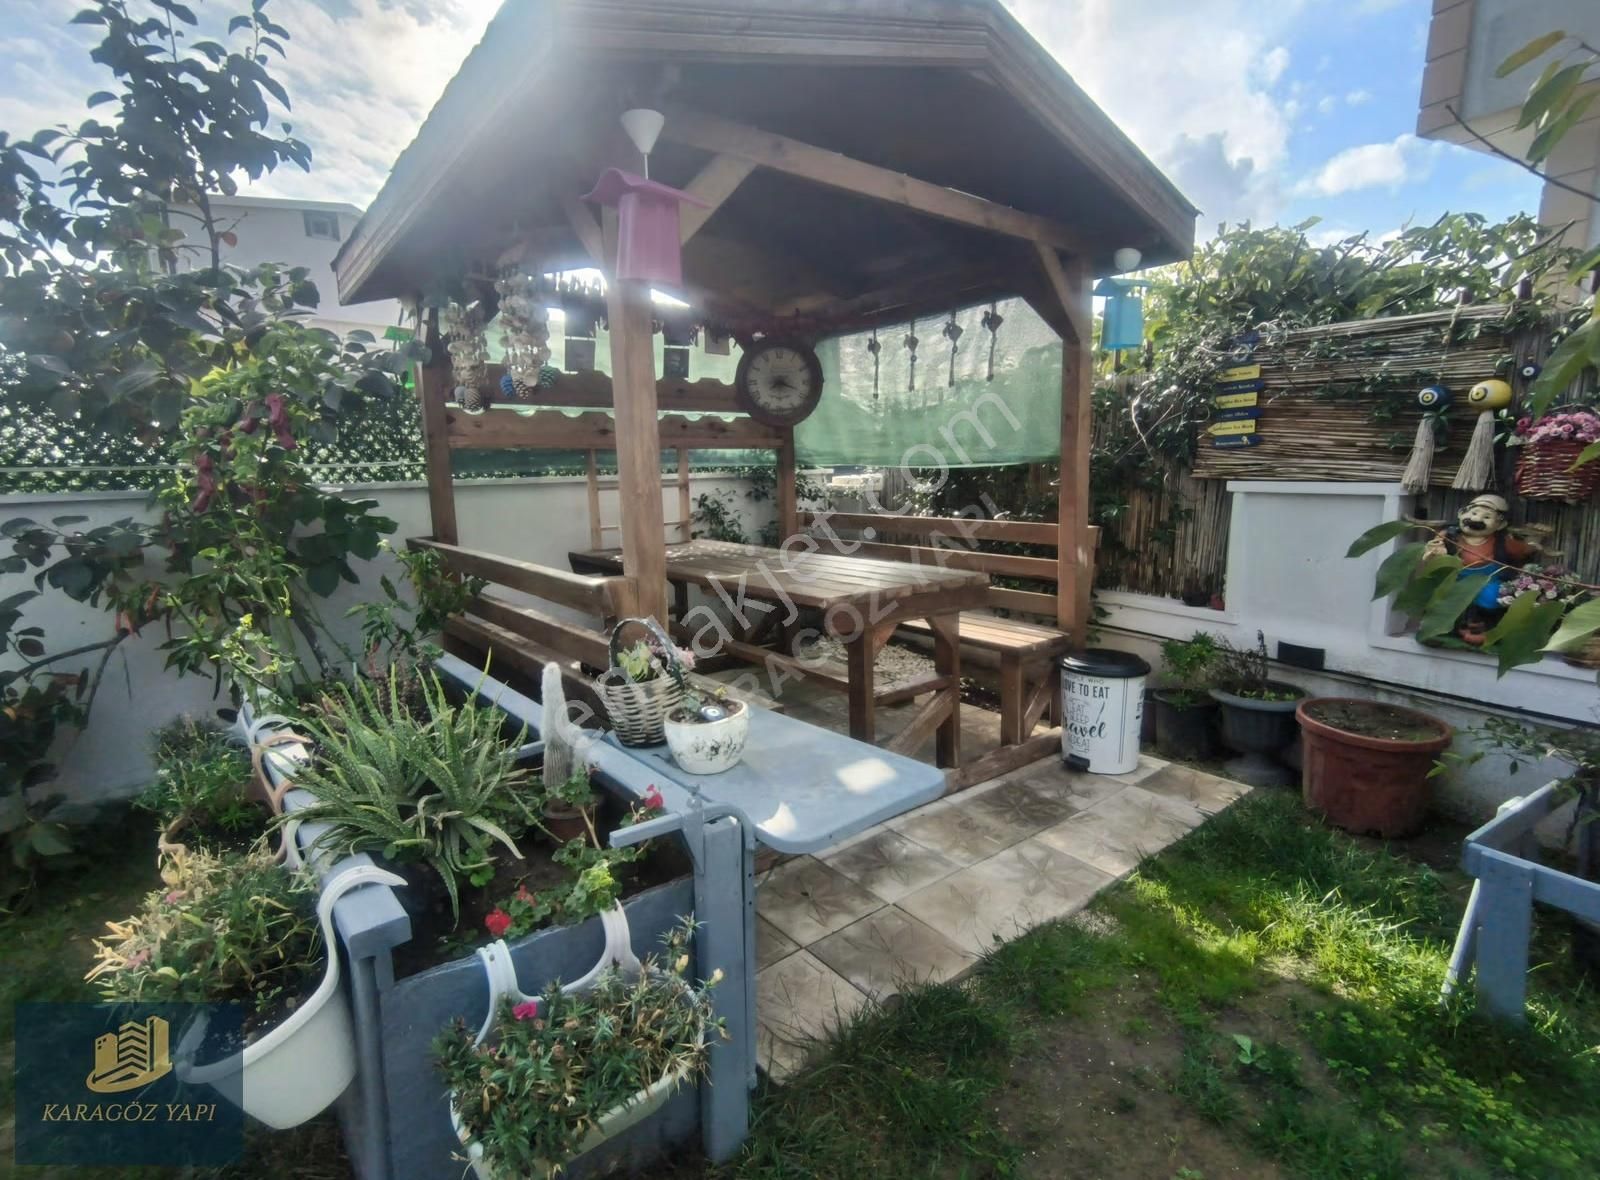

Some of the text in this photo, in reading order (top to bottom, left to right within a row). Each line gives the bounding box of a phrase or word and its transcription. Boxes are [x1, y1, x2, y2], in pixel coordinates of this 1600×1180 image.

[1063, 678, 1111, 700] OVE TO EAT
